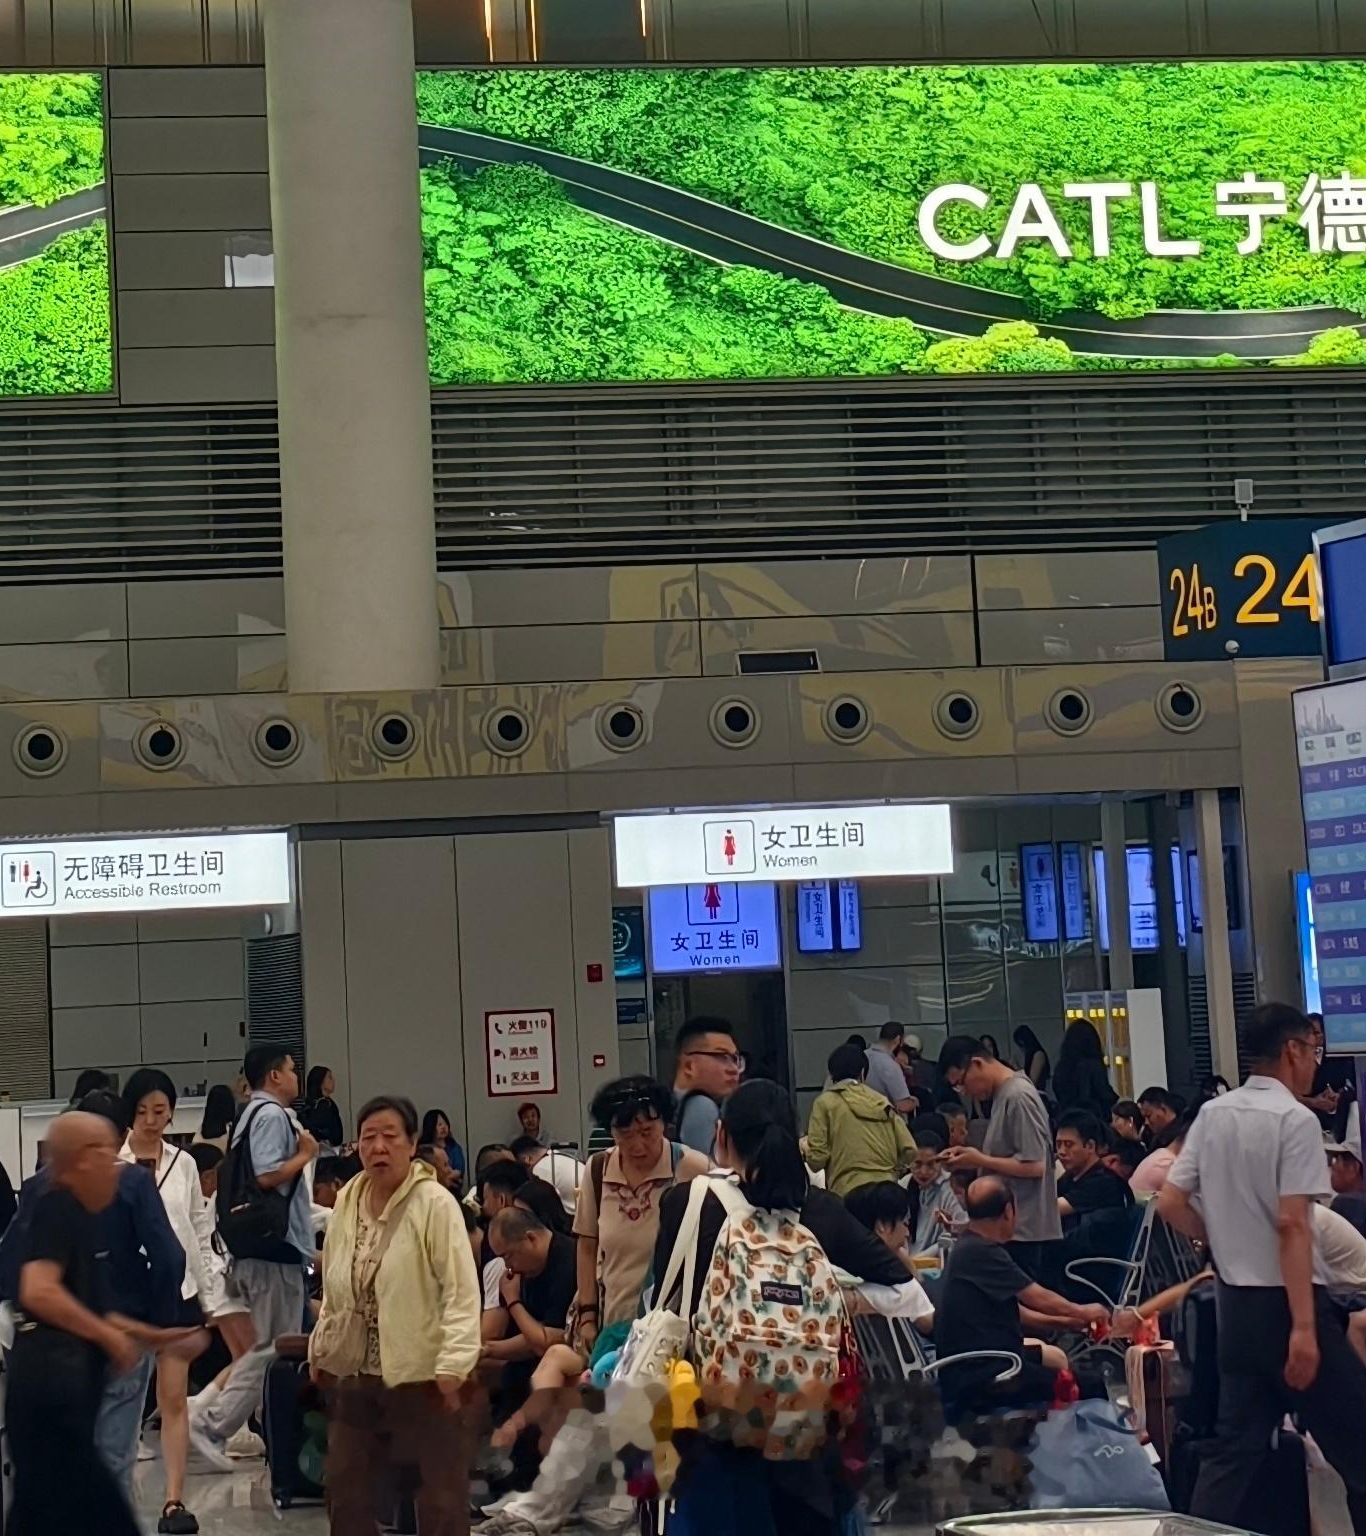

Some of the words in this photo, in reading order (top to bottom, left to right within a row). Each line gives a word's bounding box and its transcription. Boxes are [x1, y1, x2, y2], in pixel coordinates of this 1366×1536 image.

[917, 181, 1202, 260] CATL
[1170, 563, 1217, 636] 24B
[761, 822, 864, 850] 女卫生间
[64, 850, 224, 882] 无障碍卫生间
[763, 853, 817, 868] Women
[64, 884, 144, 900] Accessible
[149, 881, 222, 897] Restroom
[670, 929, 759, 952] 女卫生间
[689, 954, 740, 966] Women
